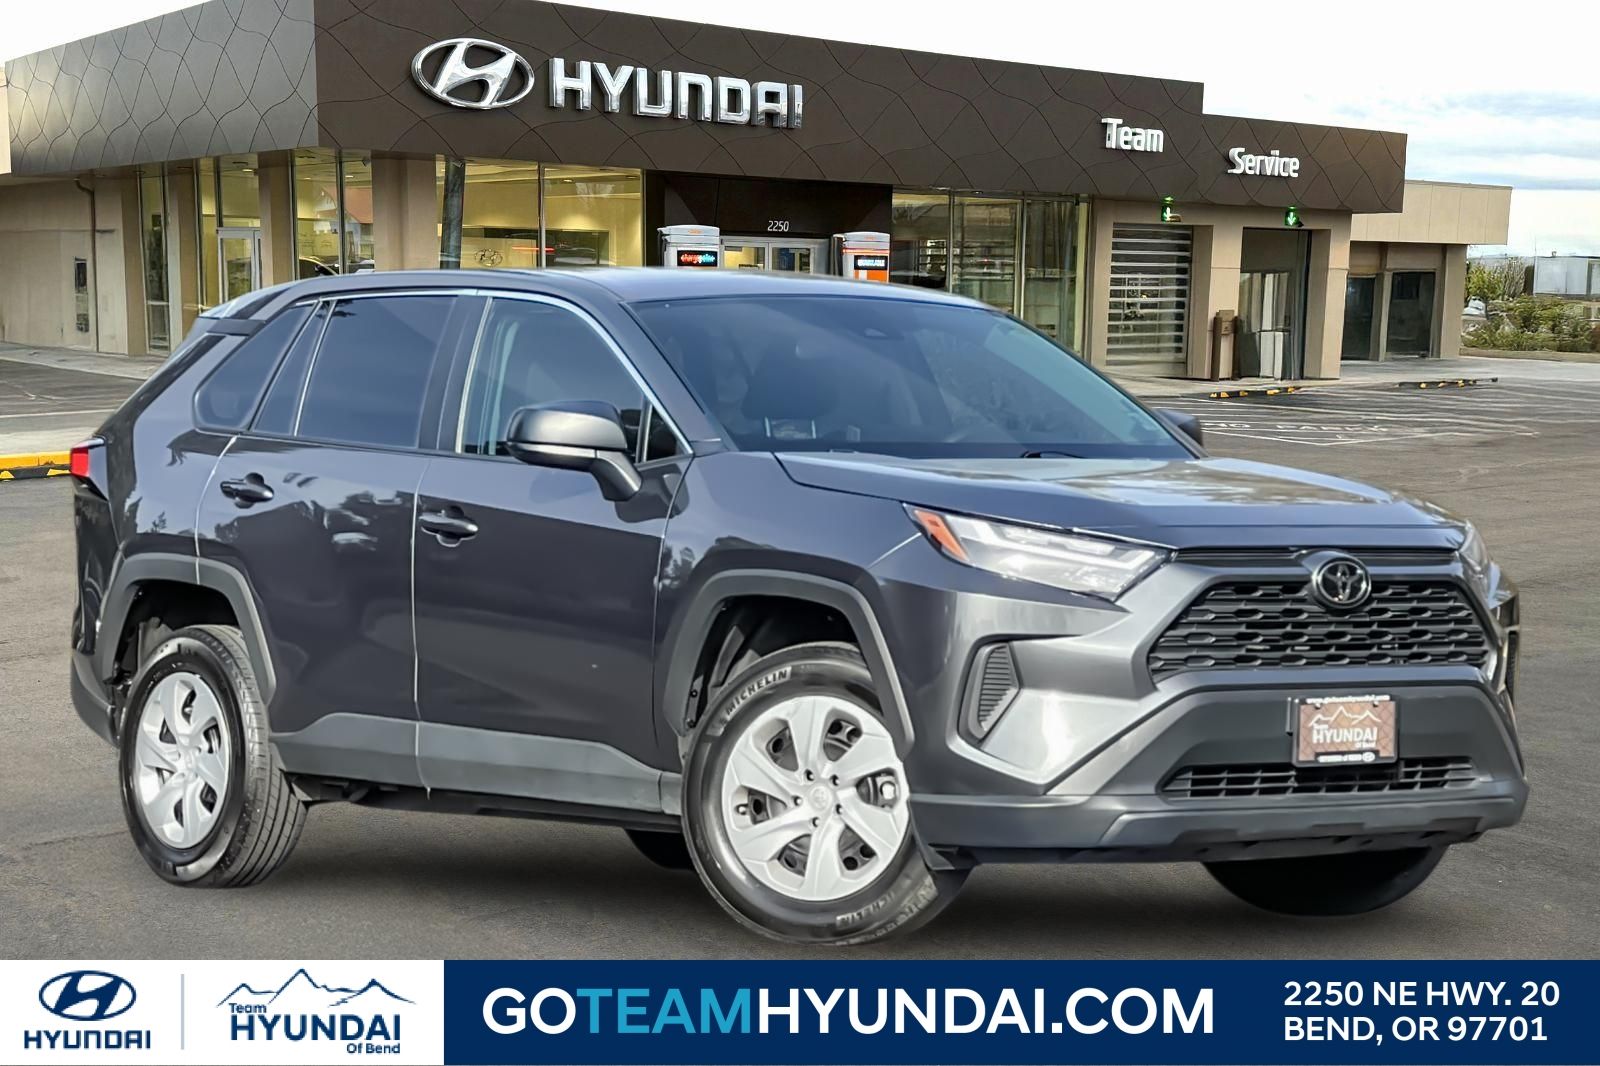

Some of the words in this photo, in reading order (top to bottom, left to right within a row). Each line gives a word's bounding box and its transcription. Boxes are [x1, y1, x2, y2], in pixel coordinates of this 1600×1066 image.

[548, 57, 803, 129] HYUNDAI
[1101, 117, 1164, 153] Team
[1227, 147, 1300, 178] Service
[767, 220, 790, 232] 2250
[725, 669, 788, 716] MICHELIN
[1312, 726, 1378, 744] HYUNDAI
